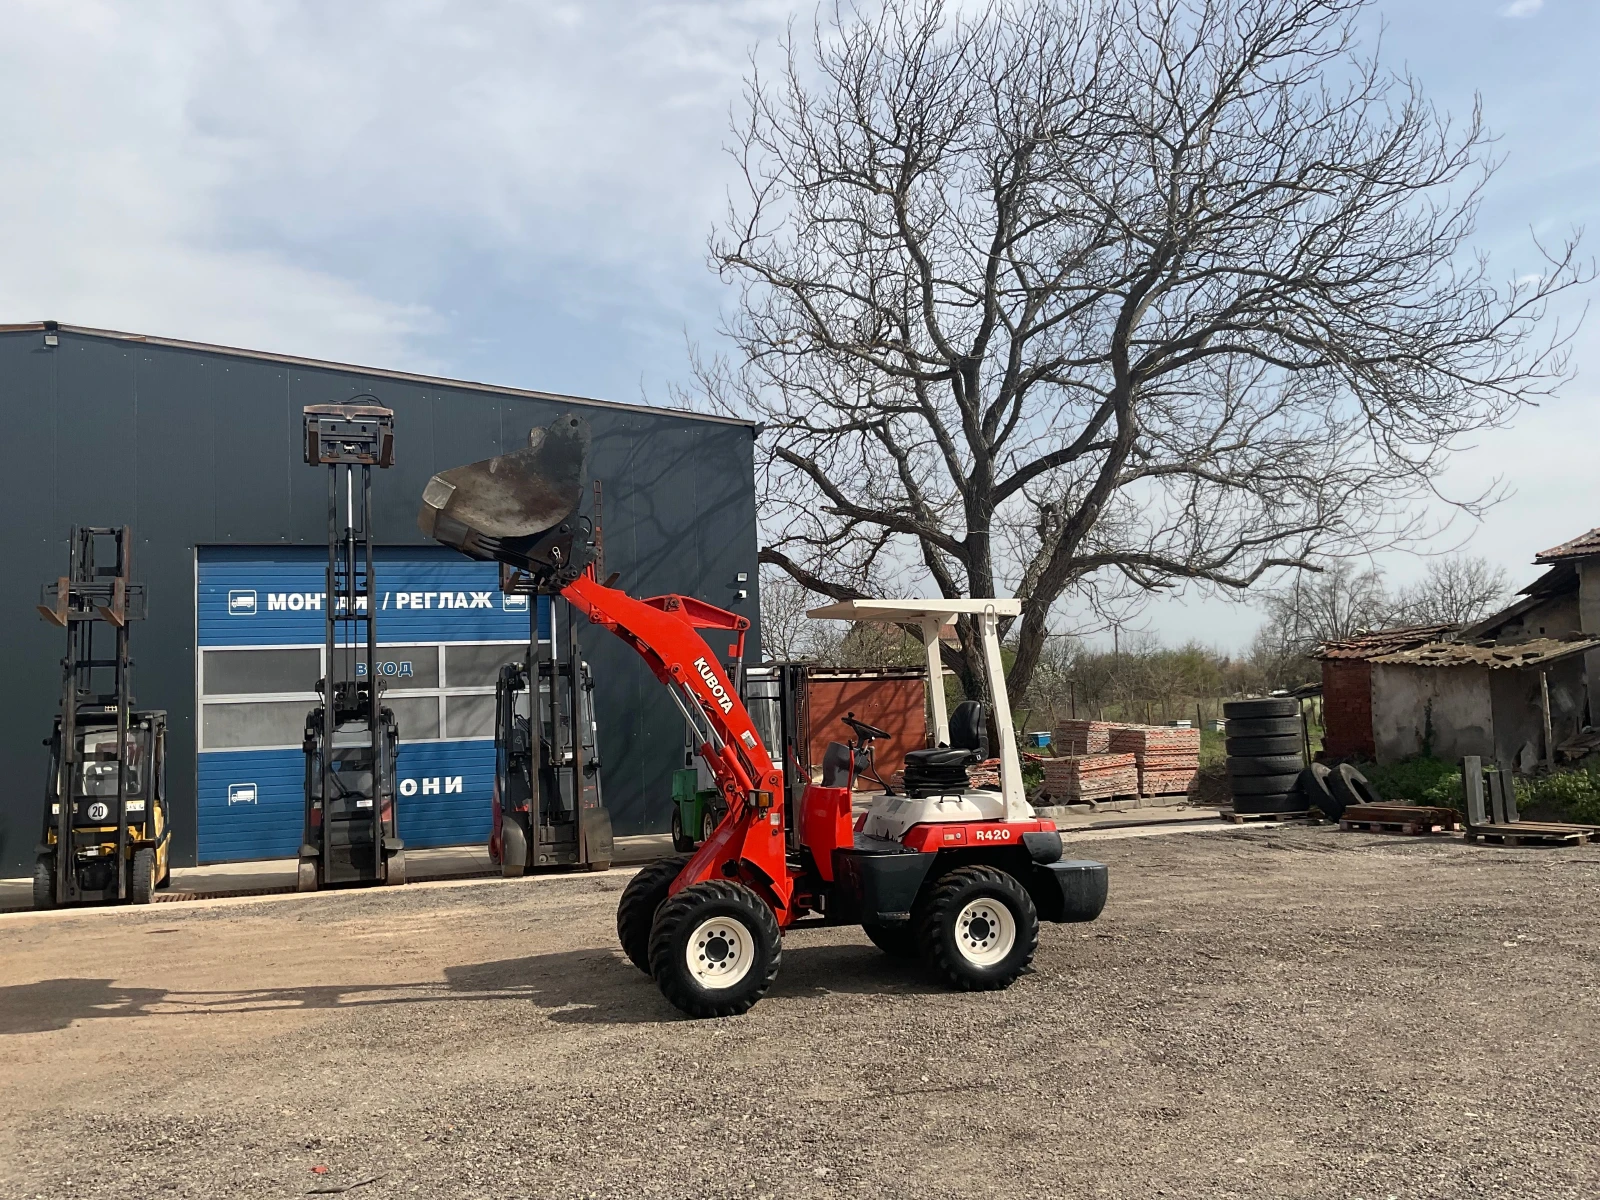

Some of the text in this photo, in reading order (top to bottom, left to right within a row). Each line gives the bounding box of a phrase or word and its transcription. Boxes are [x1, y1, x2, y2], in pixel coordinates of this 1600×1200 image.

[382, 592, 390, 610] /
[396, 592, 493, 609] РЕГЛАЖ
[693, 657, 733, 714] KUBOTA
[92, 805, 104, 817] 20
[976, 829, 1010, 841] R420
